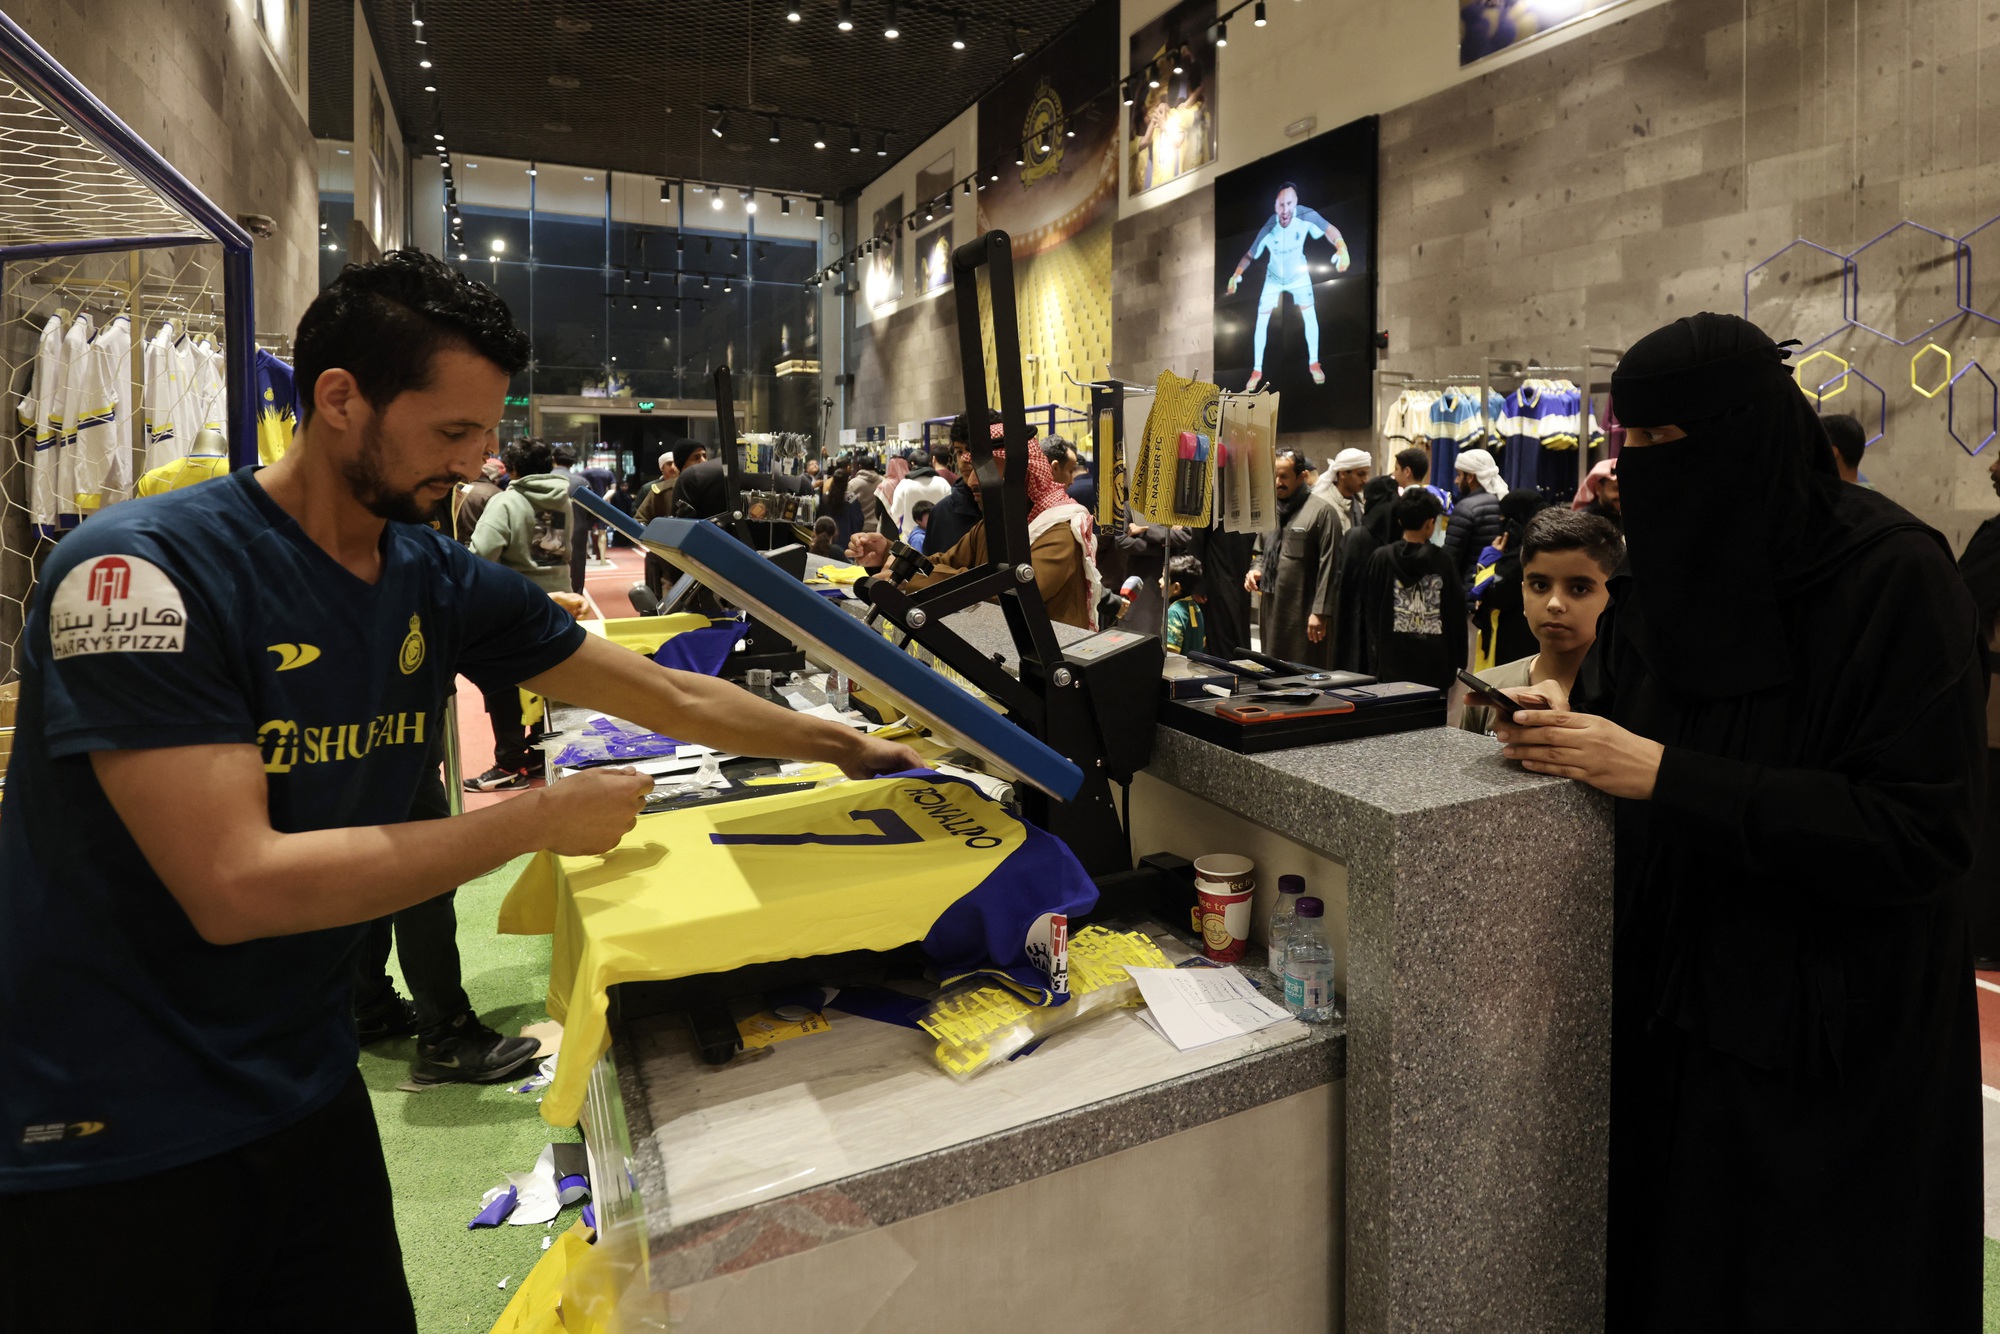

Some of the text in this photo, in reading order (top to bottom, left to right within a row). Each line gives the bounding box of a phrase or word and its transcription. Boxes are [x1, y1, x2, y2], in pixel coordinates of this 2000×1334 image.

[1150, 436, 1163, 517] AL NASSER FC
[102, 607, 182, 632] هاريز
[53, 635, 179, 658] HARRY'S PIZZA
[709, 808, 926, 846] 7
[904, 786, 1003, 849] RONALDO
